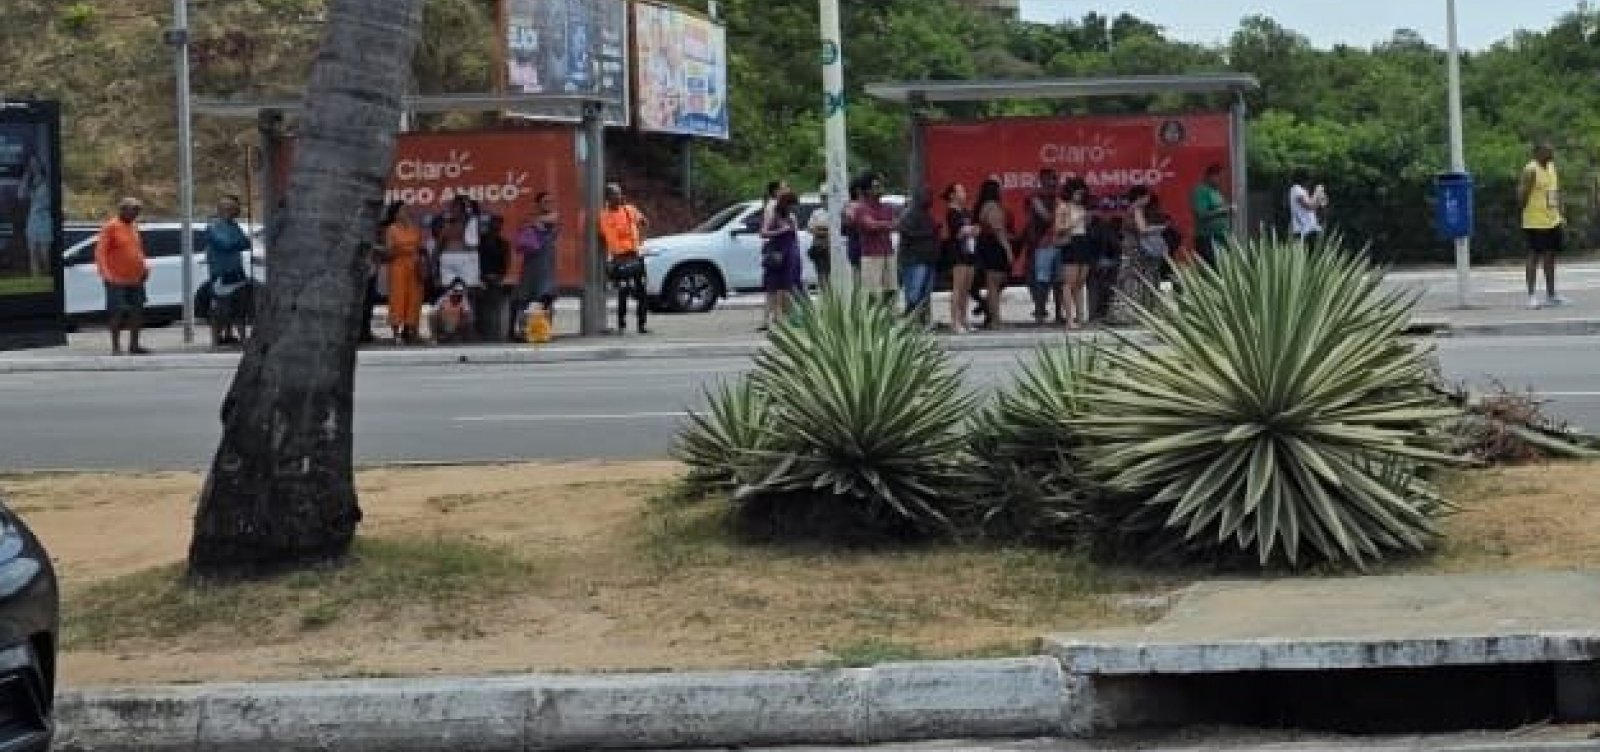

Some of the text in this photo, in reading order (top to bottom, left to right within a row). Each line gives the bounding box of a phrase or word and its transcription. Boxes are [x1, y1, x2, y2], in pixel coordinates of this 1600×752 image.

[1042, 143, 1104, 163] Claro
[397, 156, 461, 181] Claro
[1085, 168, 1163, 187] AMIGO
